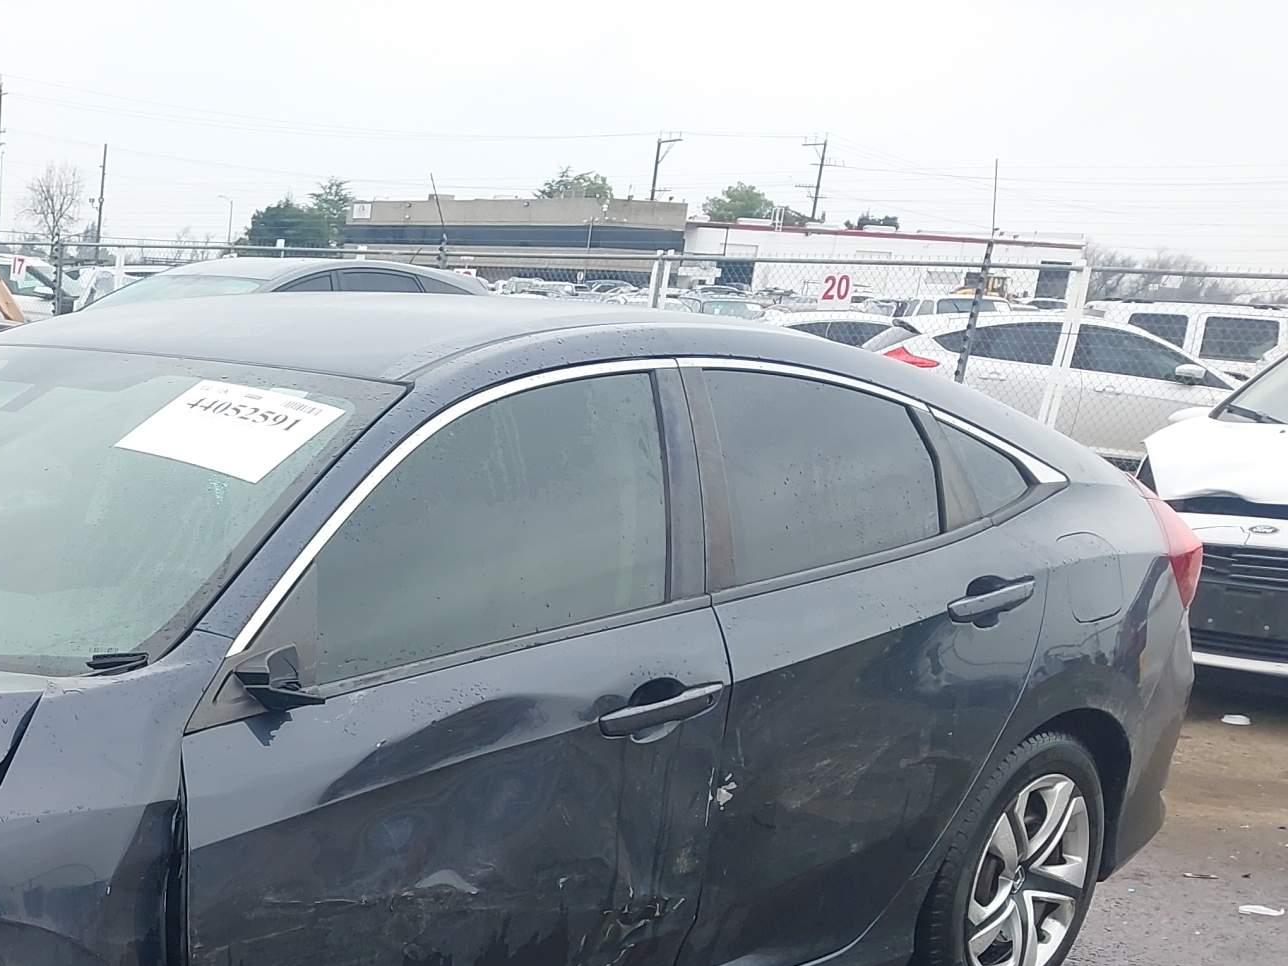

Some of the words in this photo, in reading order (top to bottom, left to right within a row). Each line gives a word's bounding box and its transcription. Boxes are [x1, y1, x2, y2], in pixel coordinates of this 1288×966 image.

[12, 257, 25, 275] 17
[821, 274, 850, 300] 20
[186, 397, 302, 431] 44052591
